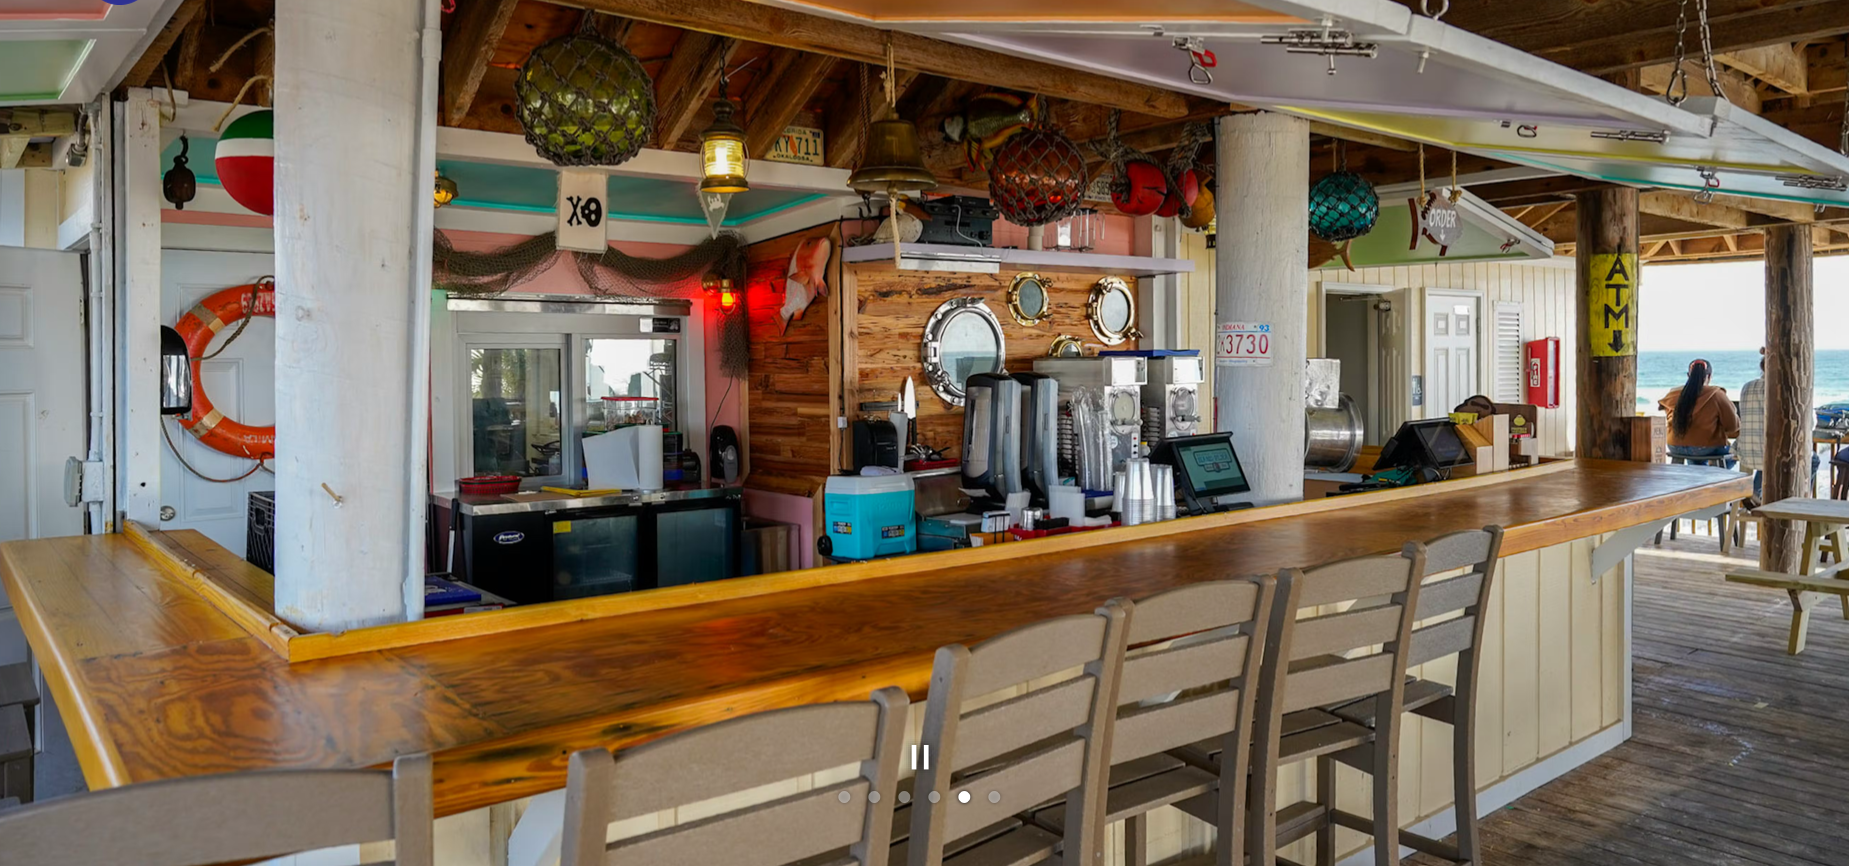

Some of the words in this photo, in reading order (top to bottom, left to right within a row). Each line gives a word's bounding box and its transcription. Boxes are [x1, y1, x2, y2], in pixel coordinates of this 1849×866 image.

[795, 136, 820, 156] 711
[1429, 208, 1457, 228] ORDER
[1604, 254, 1630, 329] ATM
[1258, 324, 1270, 333] 93
